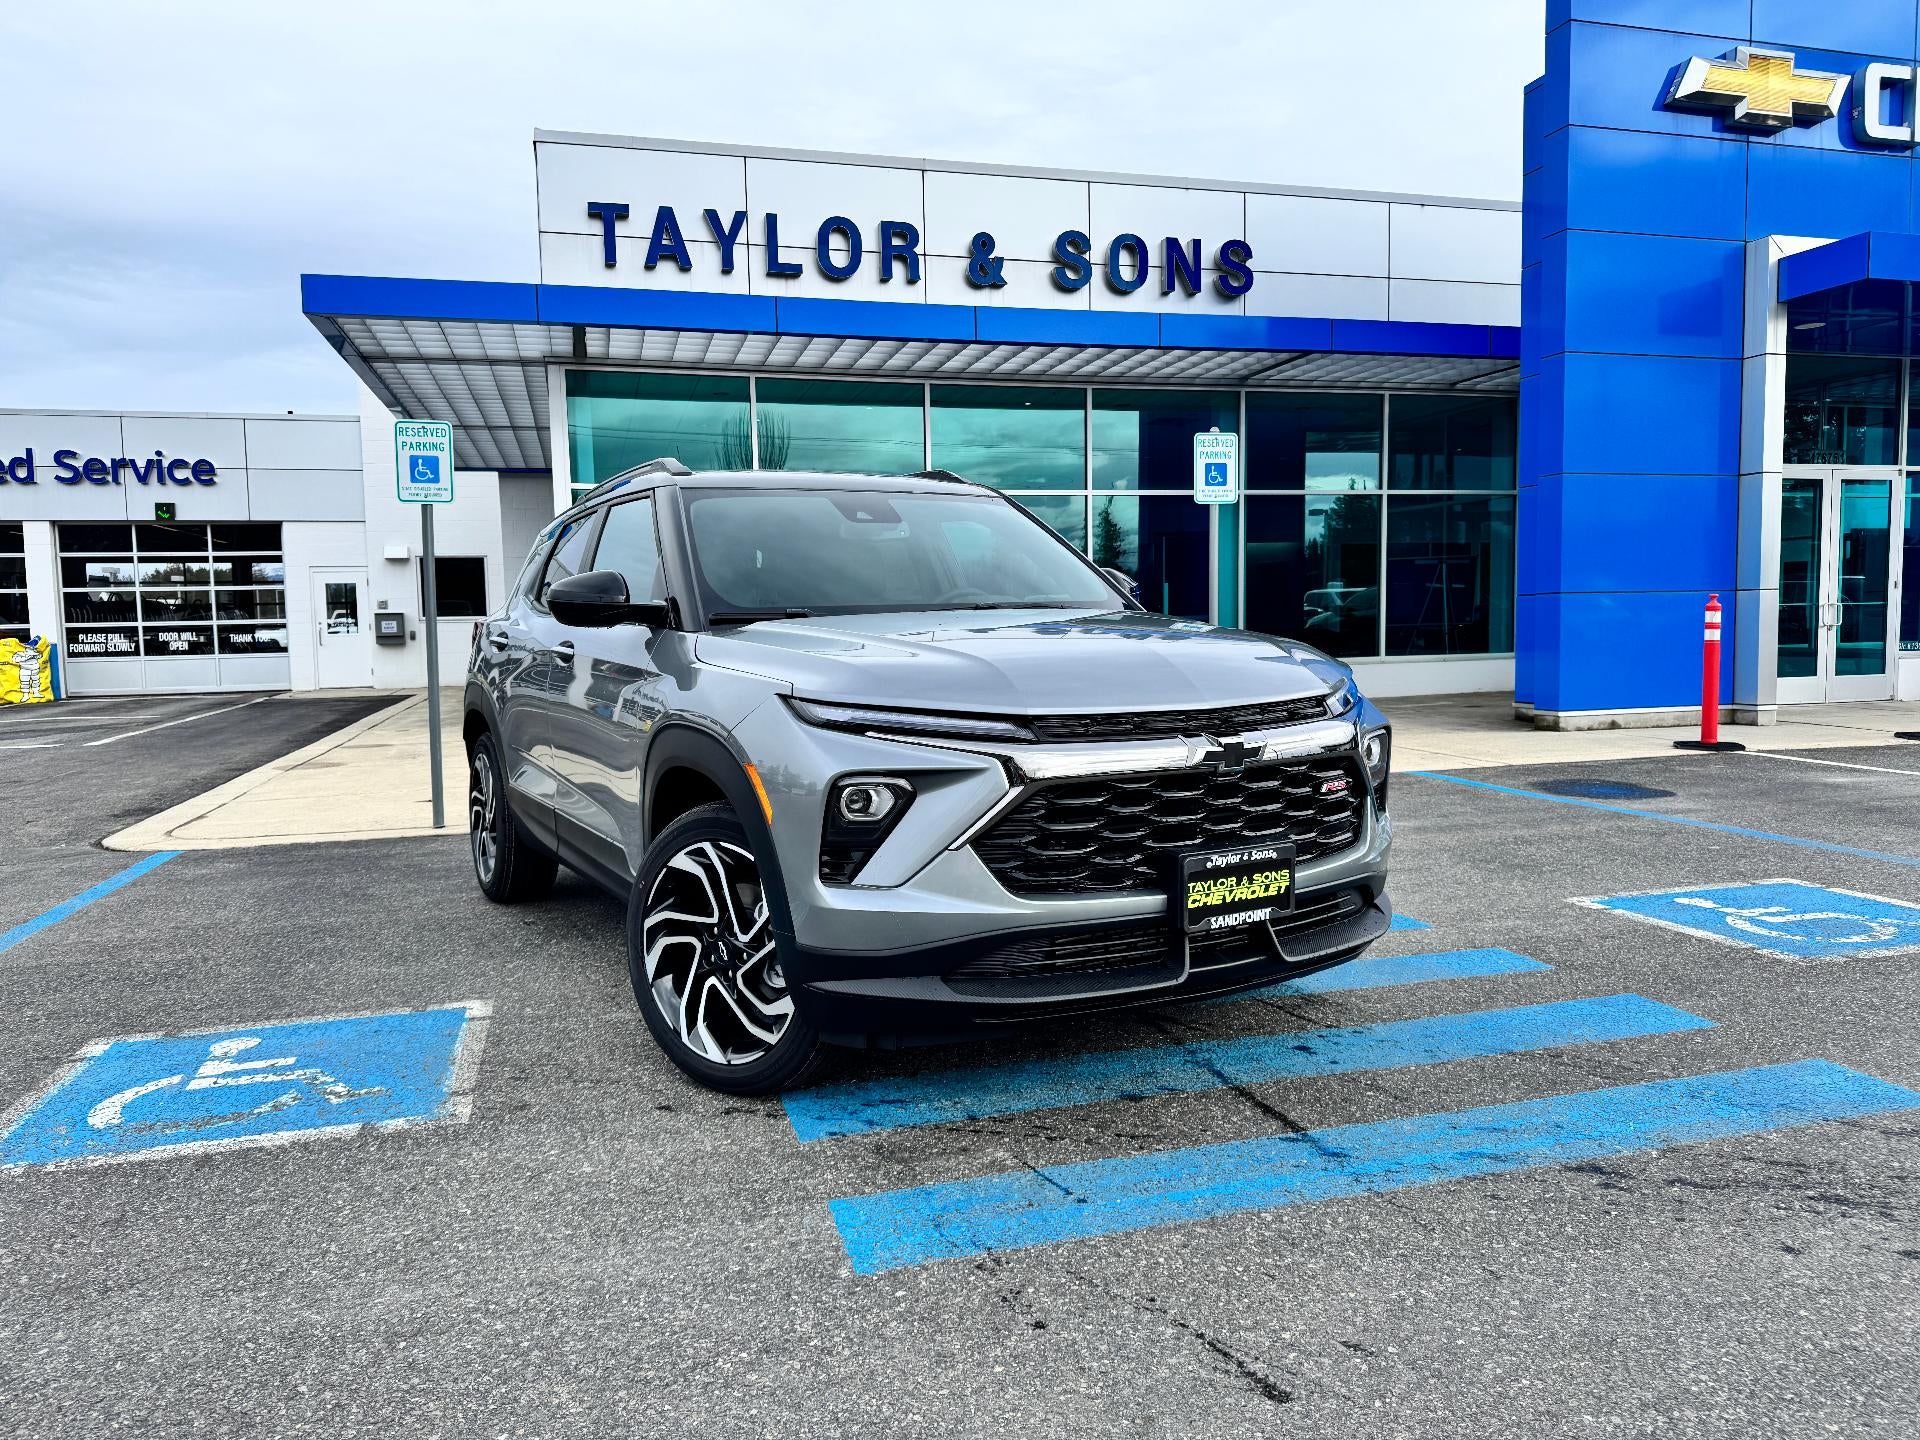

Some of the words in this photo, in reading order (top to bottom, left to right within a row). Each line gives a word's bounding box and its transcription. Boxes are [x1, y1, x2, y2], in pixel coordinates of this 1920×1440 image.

[1854, 62, 1920, 143] C
[587, 202, 921, 284] TAYLOR
[968, 232, 1007, 286] &
[1051, 230, 1254, 297] SONS
[398, 427, 446, 438] RESERVED
[401, 441, 445, 451] PARKING
[1198, 438, 1234, 448] RESERVED
[1199, 451, 1232, 460] PARKING
[53, 449, 217, 485] Service
[78, 633, 107, 643] PLEASE
[107, 633, 126, 643] PULL
[158, 632, 179, 642] DOOR
[179, 632, 198, 641] WILL
[229, 633, 253, 643] THANK
[69, 643, 106, 653] FORWARD
[106, 643, 136, 652] SLOWLY
[169, 641, 189, 651] OPEN
[1211, 853, 1241, 868] Taylor
[1250, 849, 1275, 860] Sons
[1187, 876, 1237, 893] TAYLOR
[1240, 876, 1249, 888] &
[1252, 869, 1290, 884] SONS
[1187, 881, 1290, 909] CHEVROLET
[1210, 908, 1272, 929] SANDPOINT
